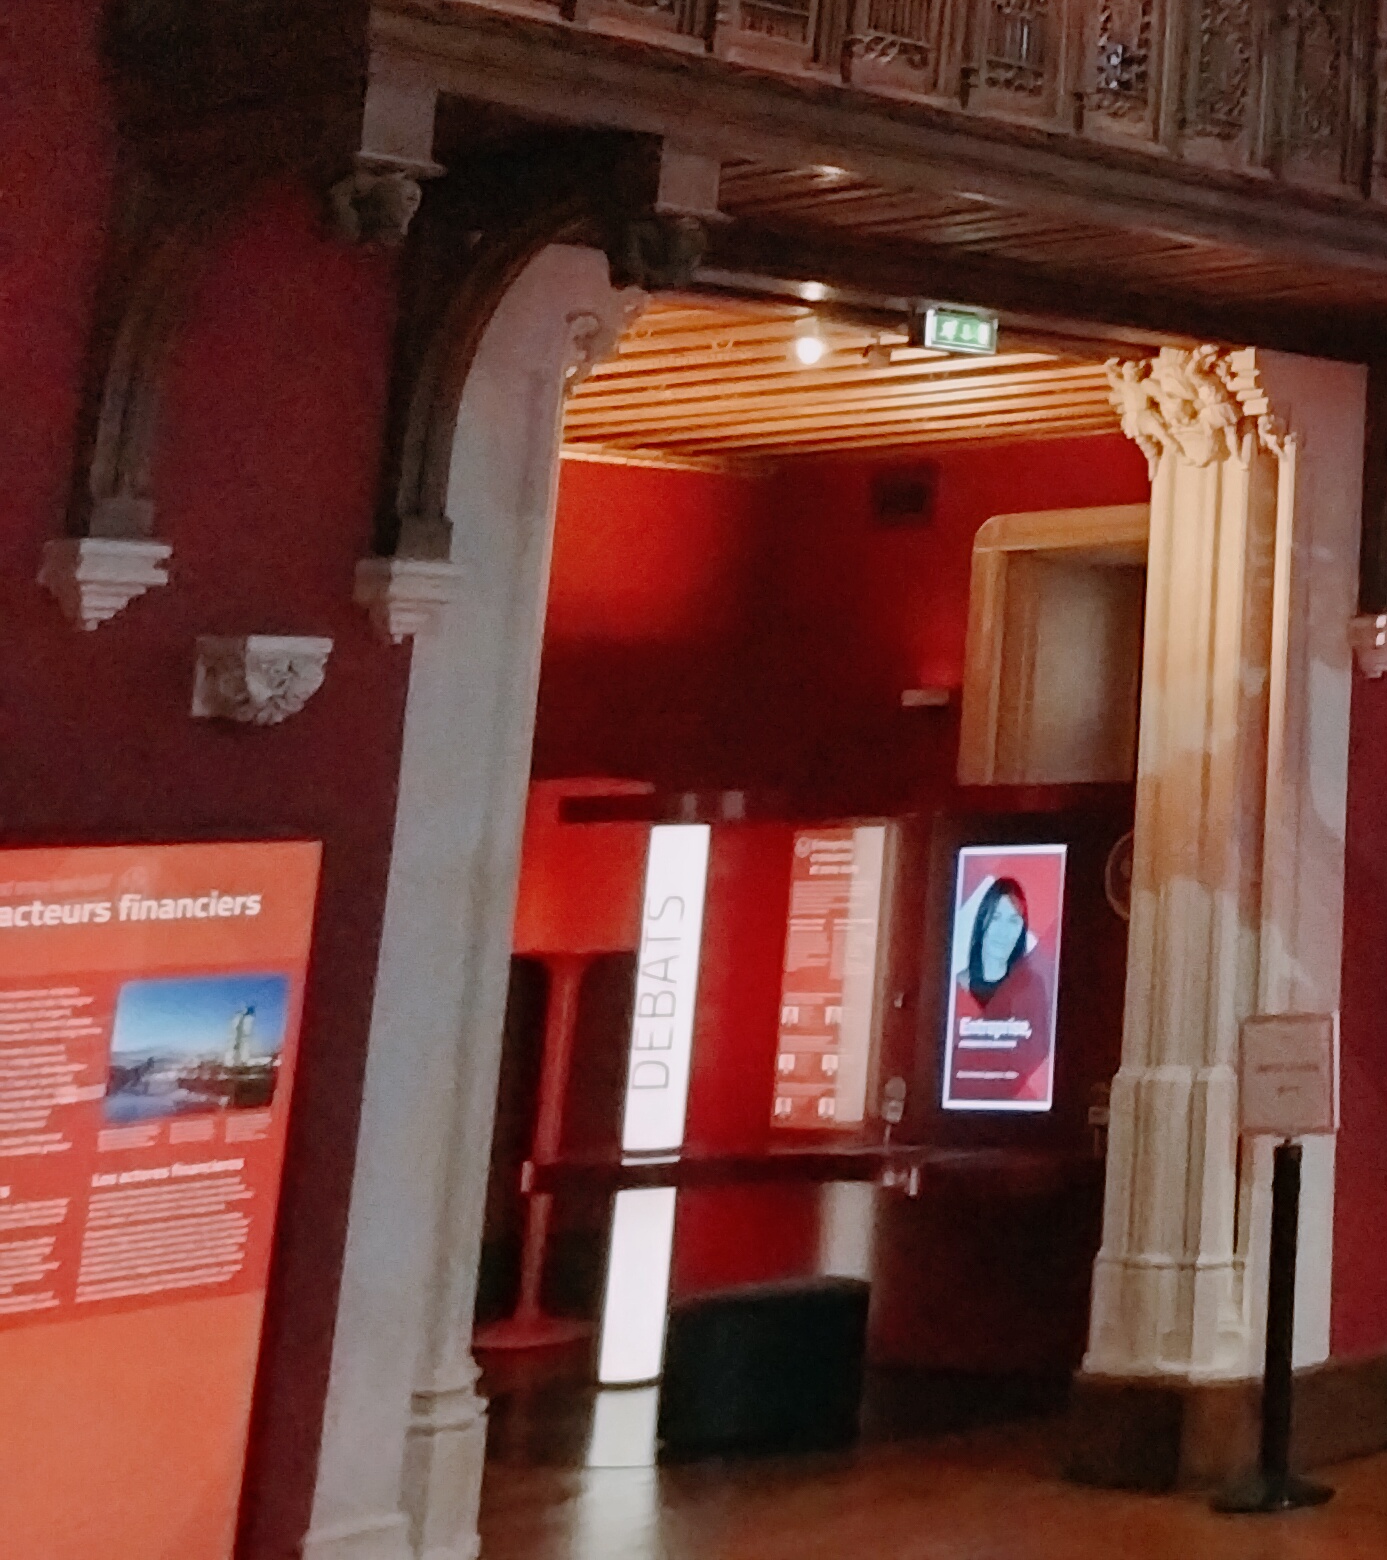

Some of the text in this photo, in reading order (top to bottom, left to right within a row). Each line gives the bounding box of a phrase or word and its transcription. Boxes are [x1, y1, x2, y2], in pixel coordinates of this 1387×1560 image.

[0, 888, 263, 928] acteurs financiers
[631, 895, 685, 1090] DEBATS
